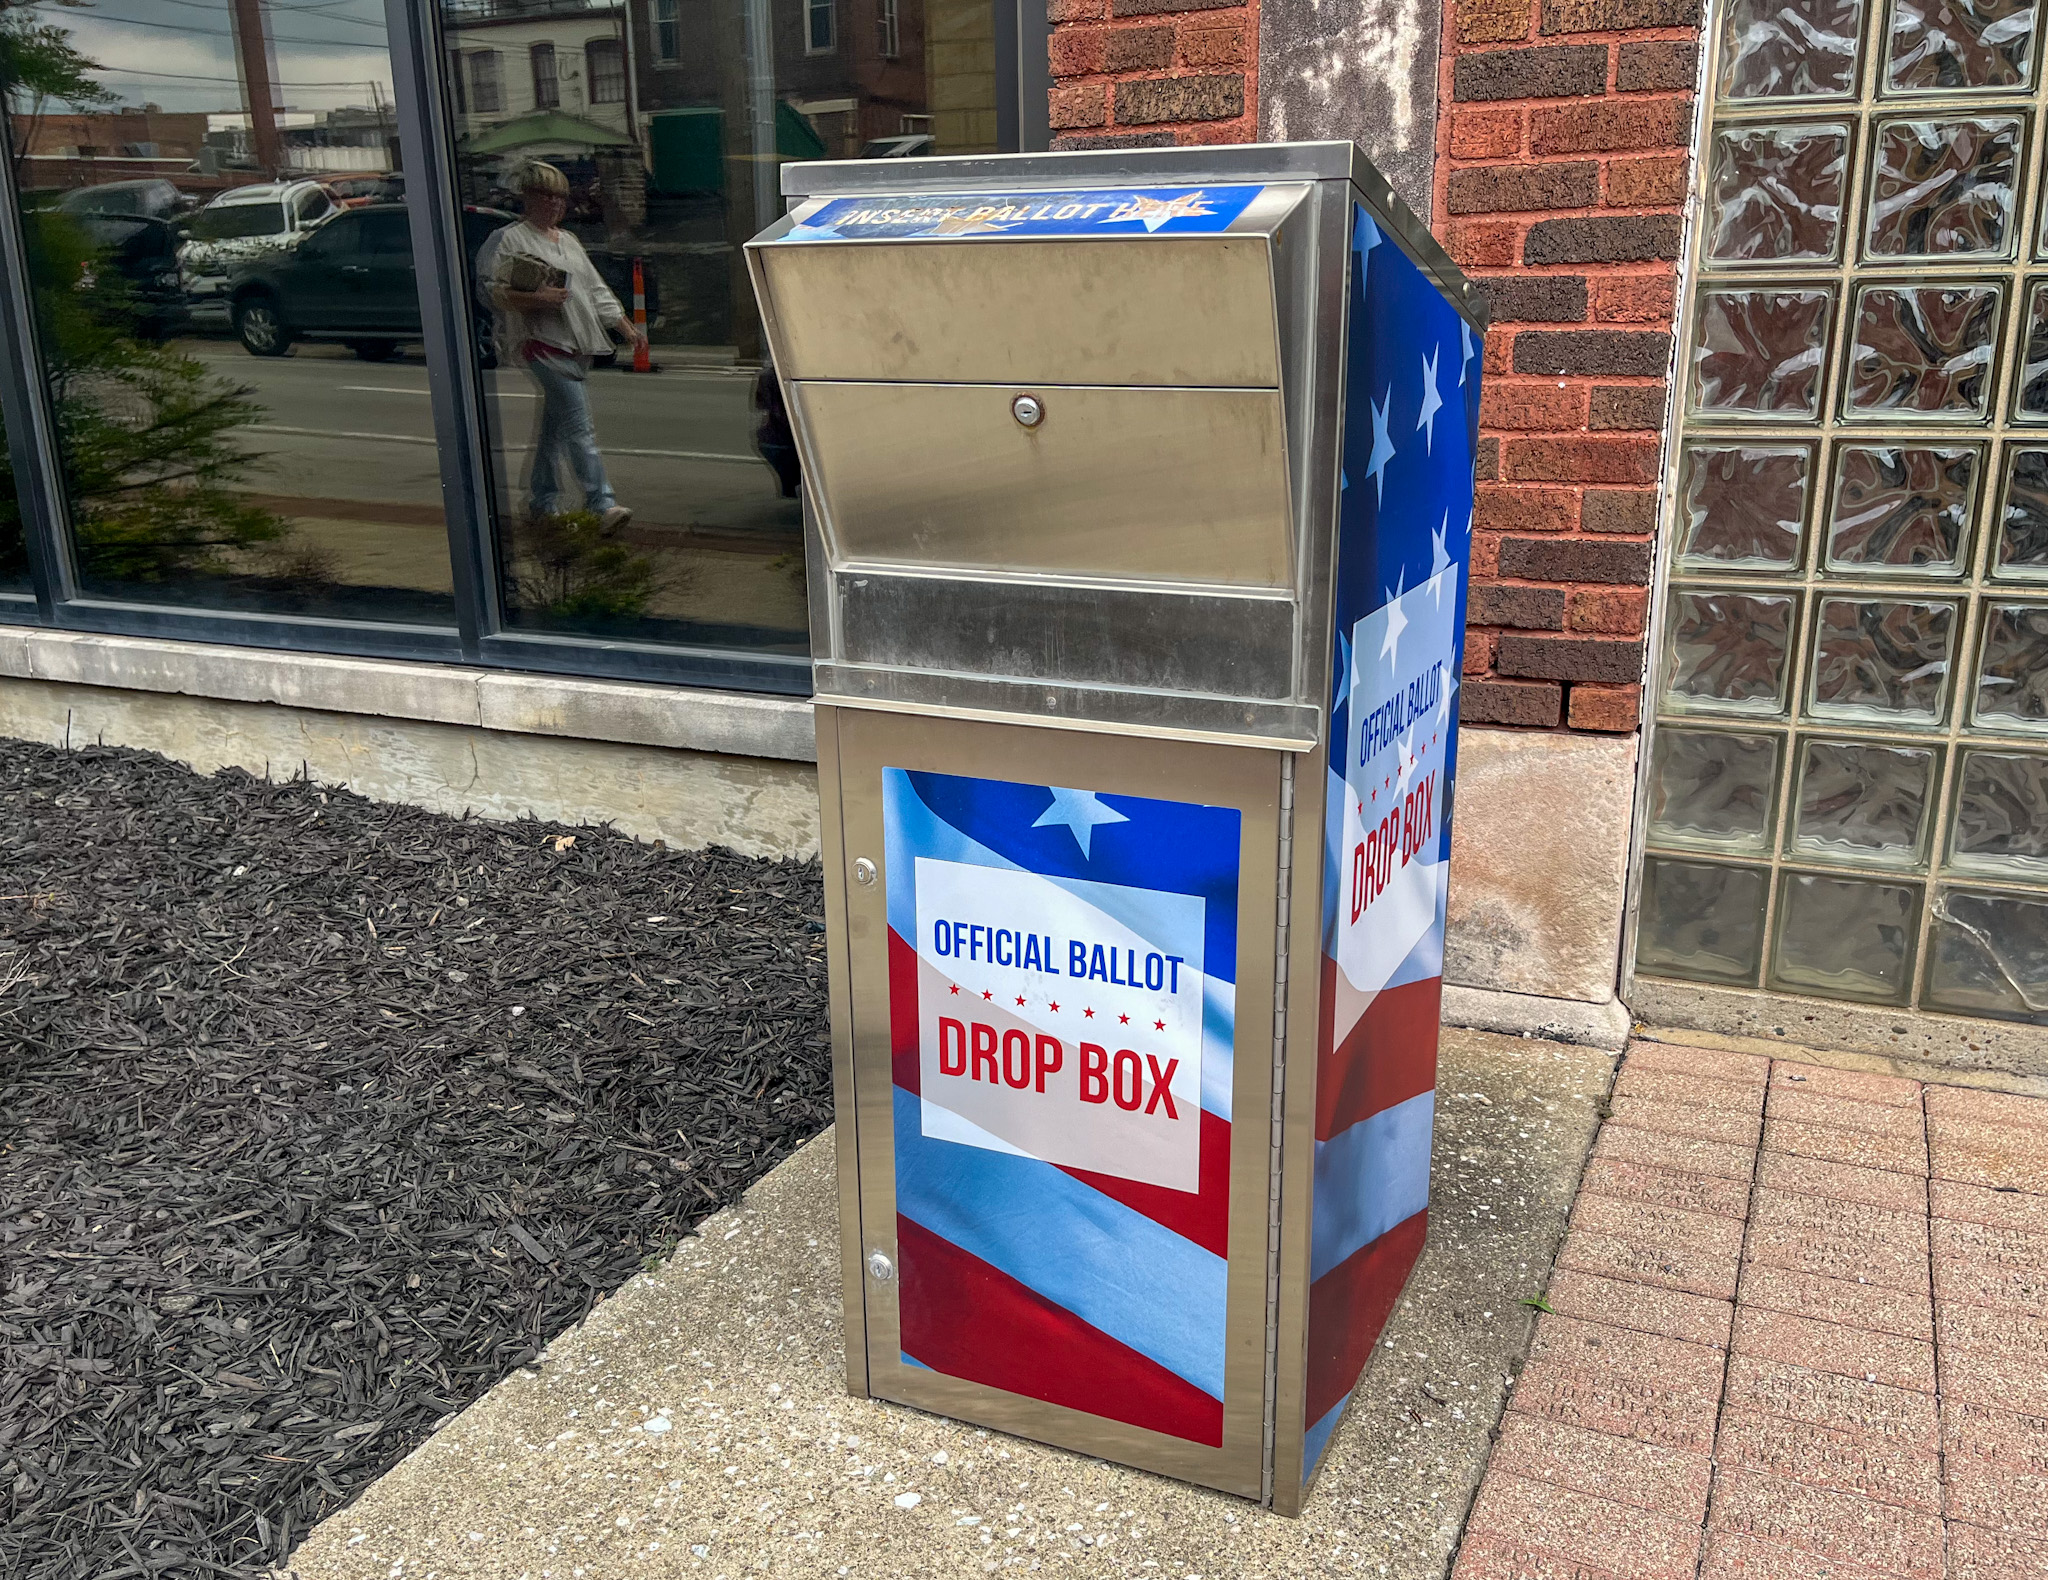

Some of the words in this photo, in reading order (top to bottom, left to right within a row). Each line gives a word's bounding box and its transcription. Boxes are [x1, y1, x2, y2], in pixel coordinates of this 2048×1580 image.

[834, 206, 967, 226] INSERT
[964, 202, 1110, 222] BALLOT
[1359, 688, 1405, 768] OFFICIAL
[1406, 659, 1443, 729] BALLOT
[1350, 805, 1400, 928] DROP
[1401, 768, 1436, 869] BOX
[934, 919, 1060, 975] OFFICIAL
[1068, 939, 1185, 995] BALLOT
[938, 1015, 1064, 1095] DROP
[1079, 1041, 1180, 1121] BOX
